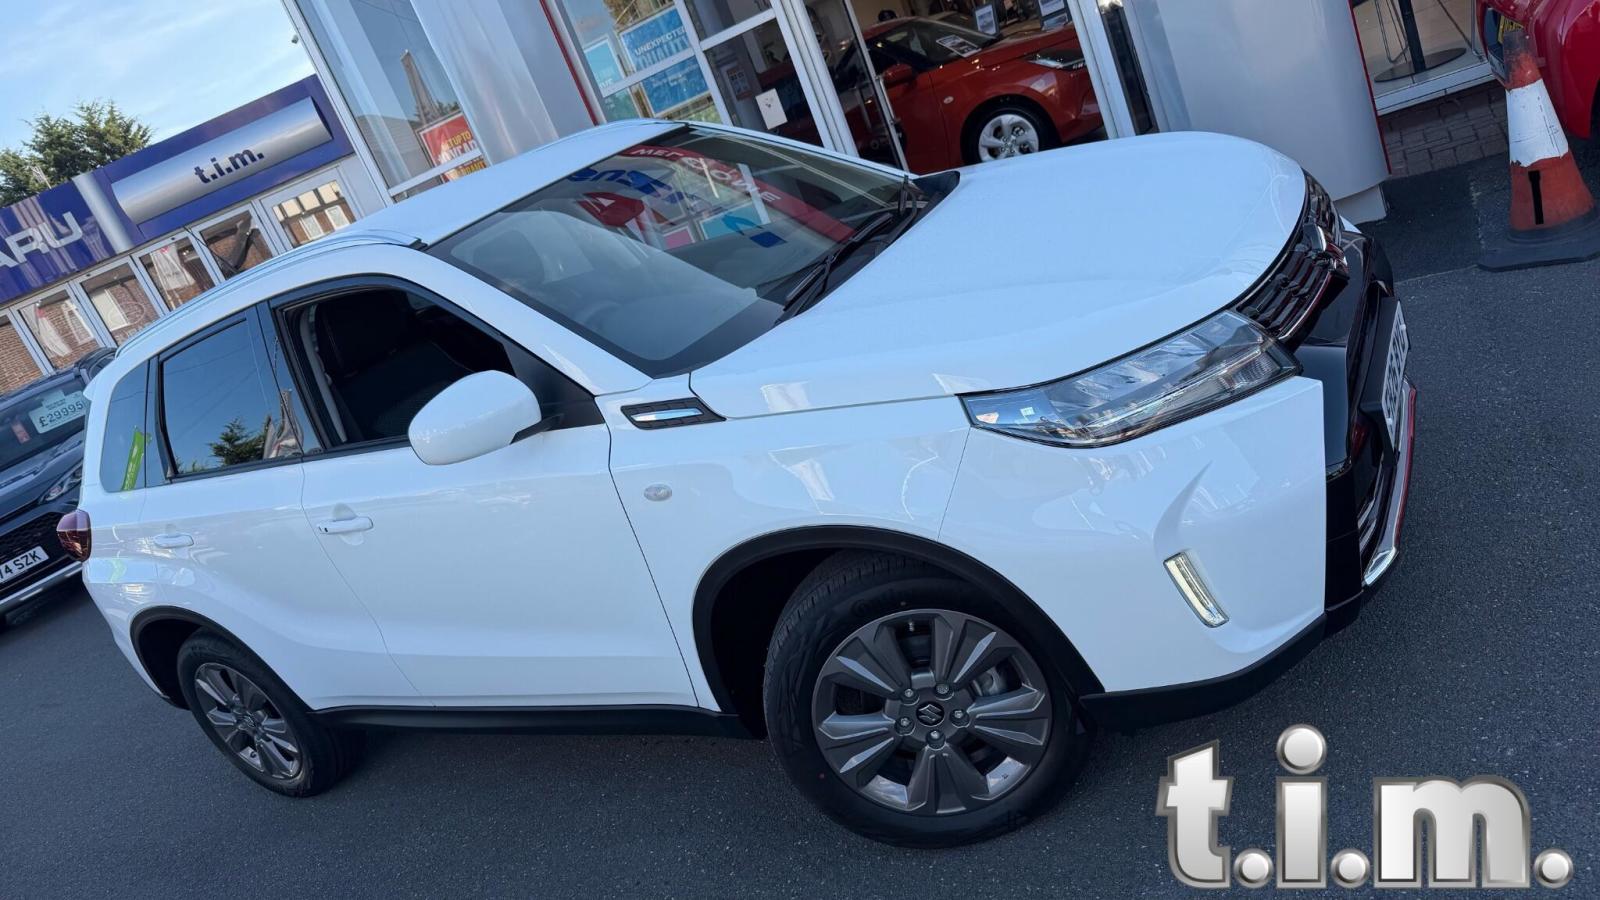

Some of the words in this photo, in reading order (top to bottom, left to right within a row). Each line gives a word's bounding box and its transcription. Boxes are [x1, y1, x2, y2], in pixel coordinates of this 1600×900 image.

[194, 147, 265, 184] t.i.m.
[39, 400, 84, 427] £29995
[13, 550, 42, 570] SZK
